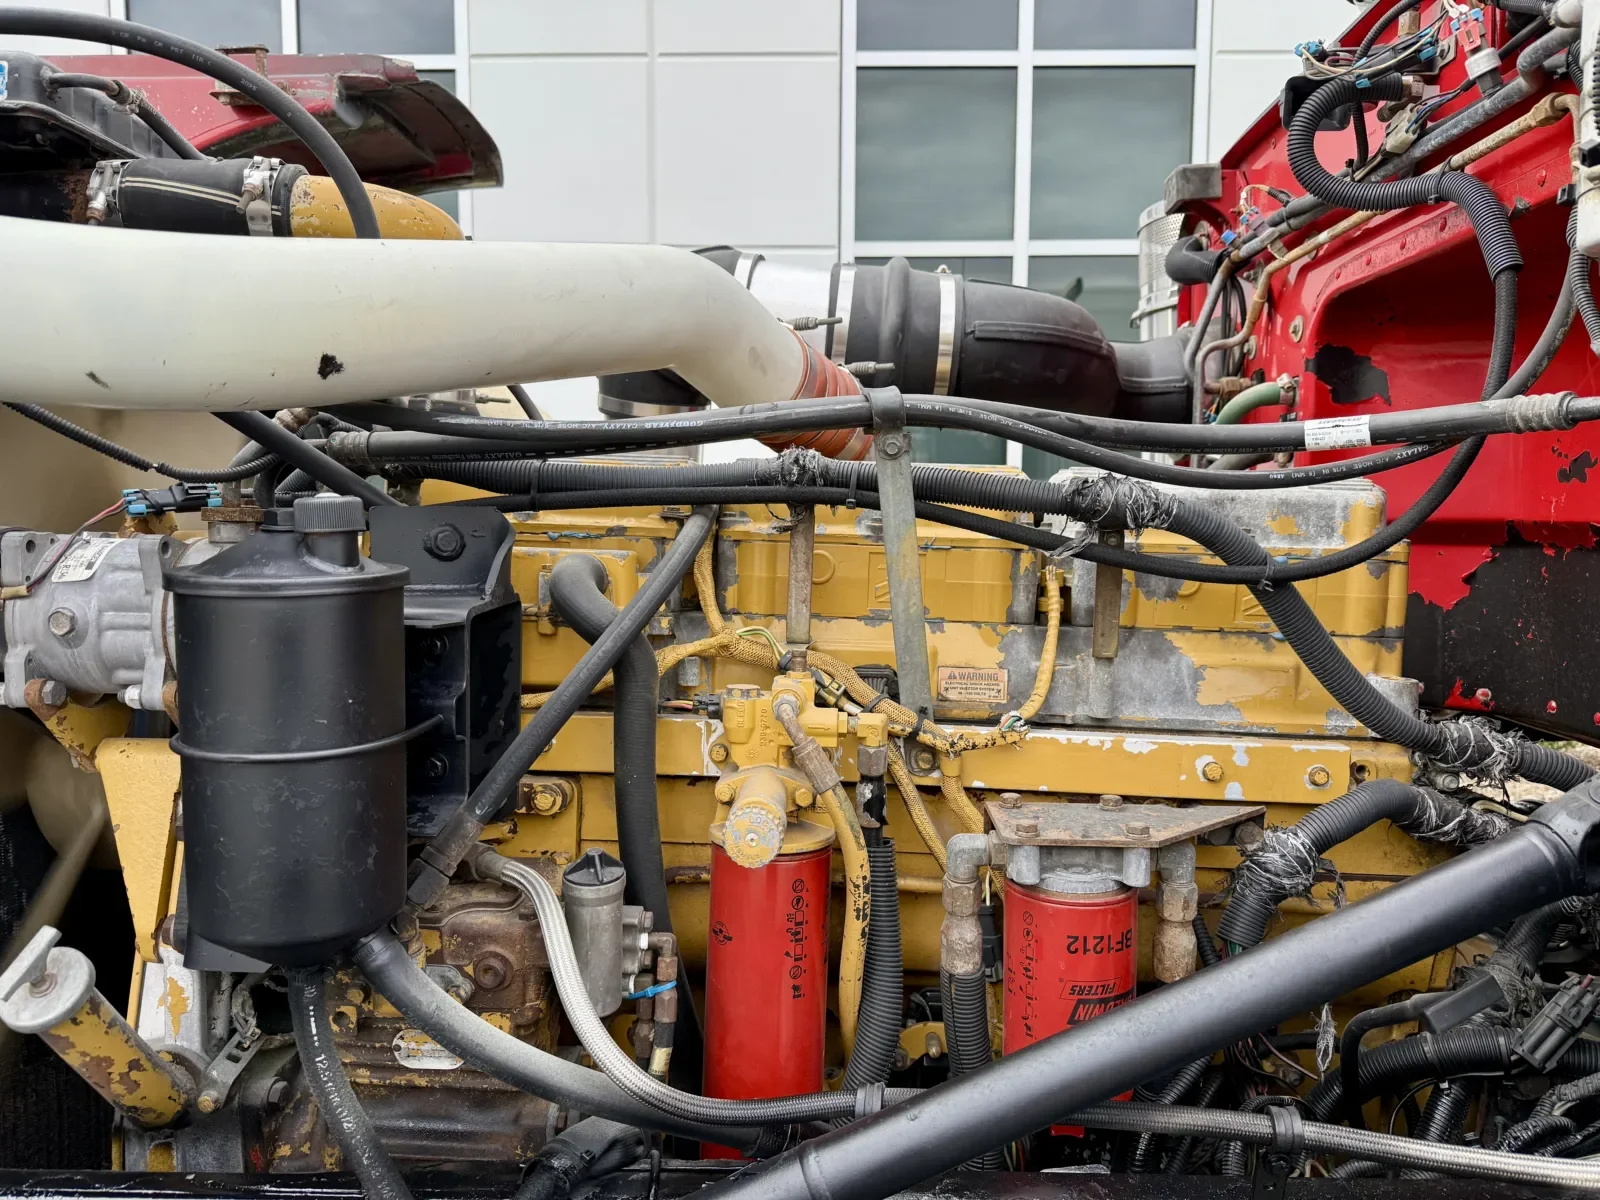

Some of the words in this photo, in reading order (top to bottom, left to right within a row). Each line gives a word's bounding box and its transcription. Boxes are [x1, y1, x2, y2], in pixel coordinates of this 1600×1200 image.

[1395, 444, 1429, 460] GALAXY
[1352, 462, 1373, 470] HOSE
[958, 672, 999, 681] WARNING
[1066, 927, 1133, 955] BF1212
[1068, 982, 1117, 996] FILTERS
